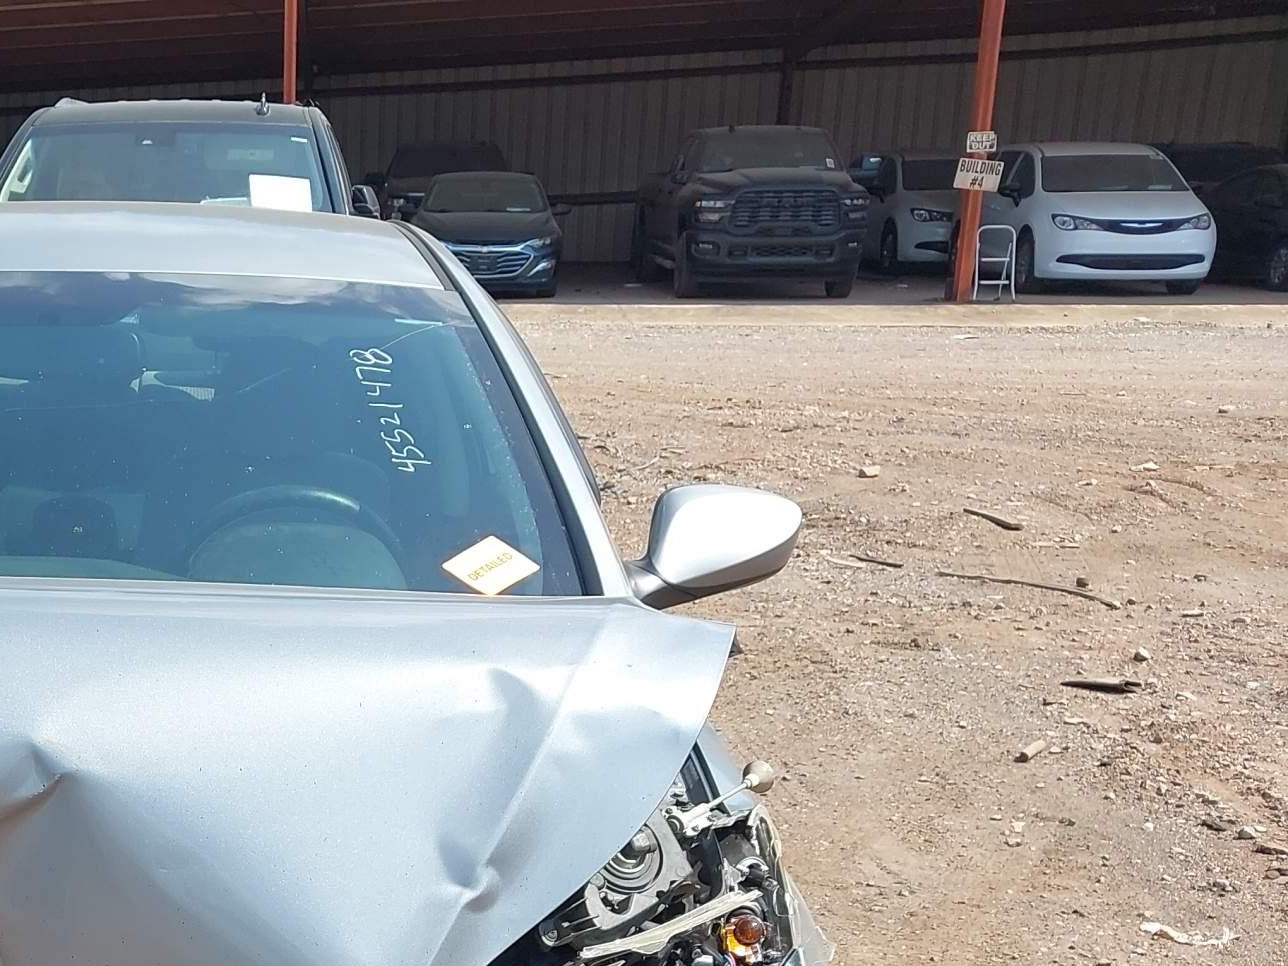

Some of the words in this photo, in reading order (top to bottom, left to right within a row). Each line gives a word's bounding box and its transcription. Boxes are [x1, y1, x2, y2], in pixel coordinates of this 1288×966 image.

[968, 133, 995, 142] KEEP
[971, 142, 993, 150] OUT
[959, 159, 1002, 176] BUILDING
[969, 175, 985, 188] #4
[349, 348, 432, 473] 45521478
[467, 551, 513, 581] DETAILED
